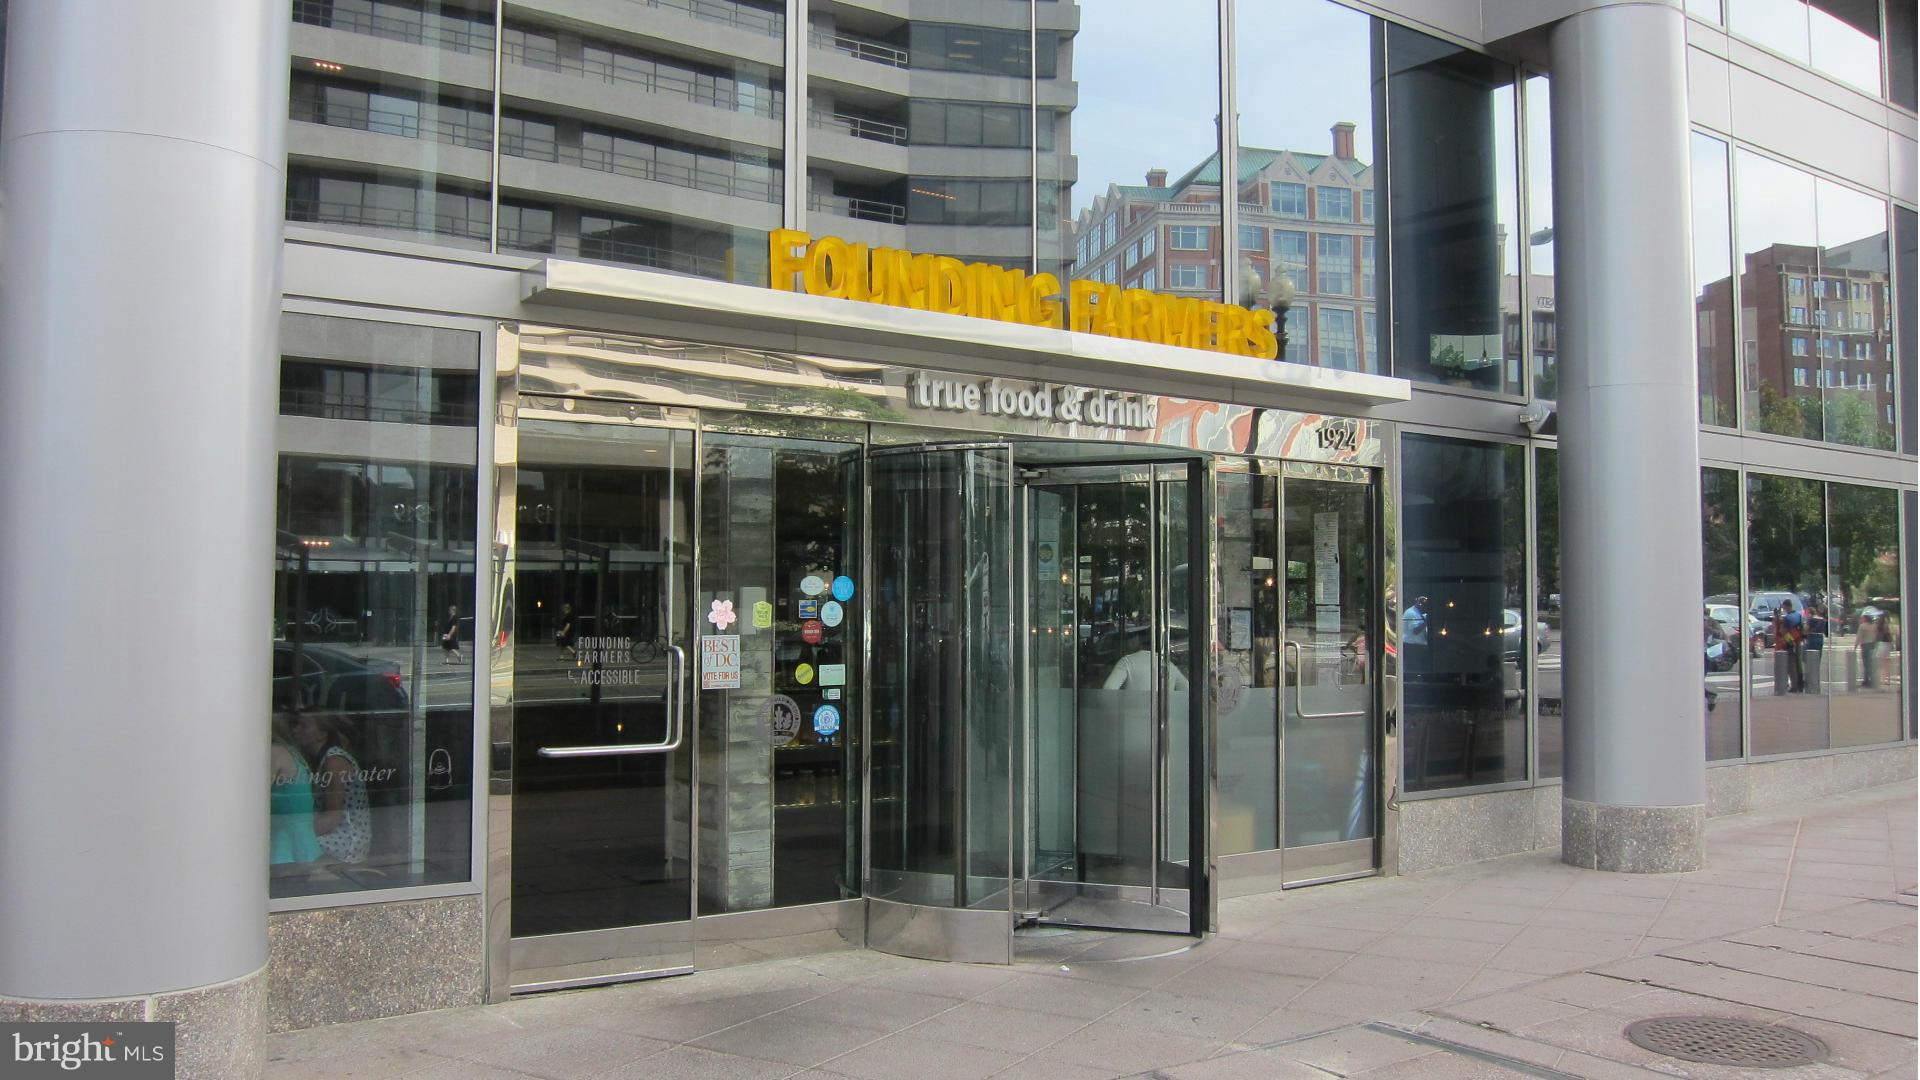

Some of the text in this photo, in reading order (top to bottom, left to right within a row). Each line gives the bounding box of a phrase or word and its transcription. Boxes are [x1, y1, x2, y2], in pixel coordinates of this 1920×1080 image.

[769, 228, 1279, 361] FOUNDING FARMERS
[912, 371, 1157, 430] true food & drink
[1316, 427, 1357, 451] 1924
[578, 637, 631, 649] FOUNDING
[704, 639, 738, 652] BEST
[578, 651, 631, 663] FARMERS
[580, 669, 640, 685] ACCESSIBLE
[703, 671, 717, 680] VOTE
[731, 671, 739, 680] US
[339, 766, 397, 784] water
